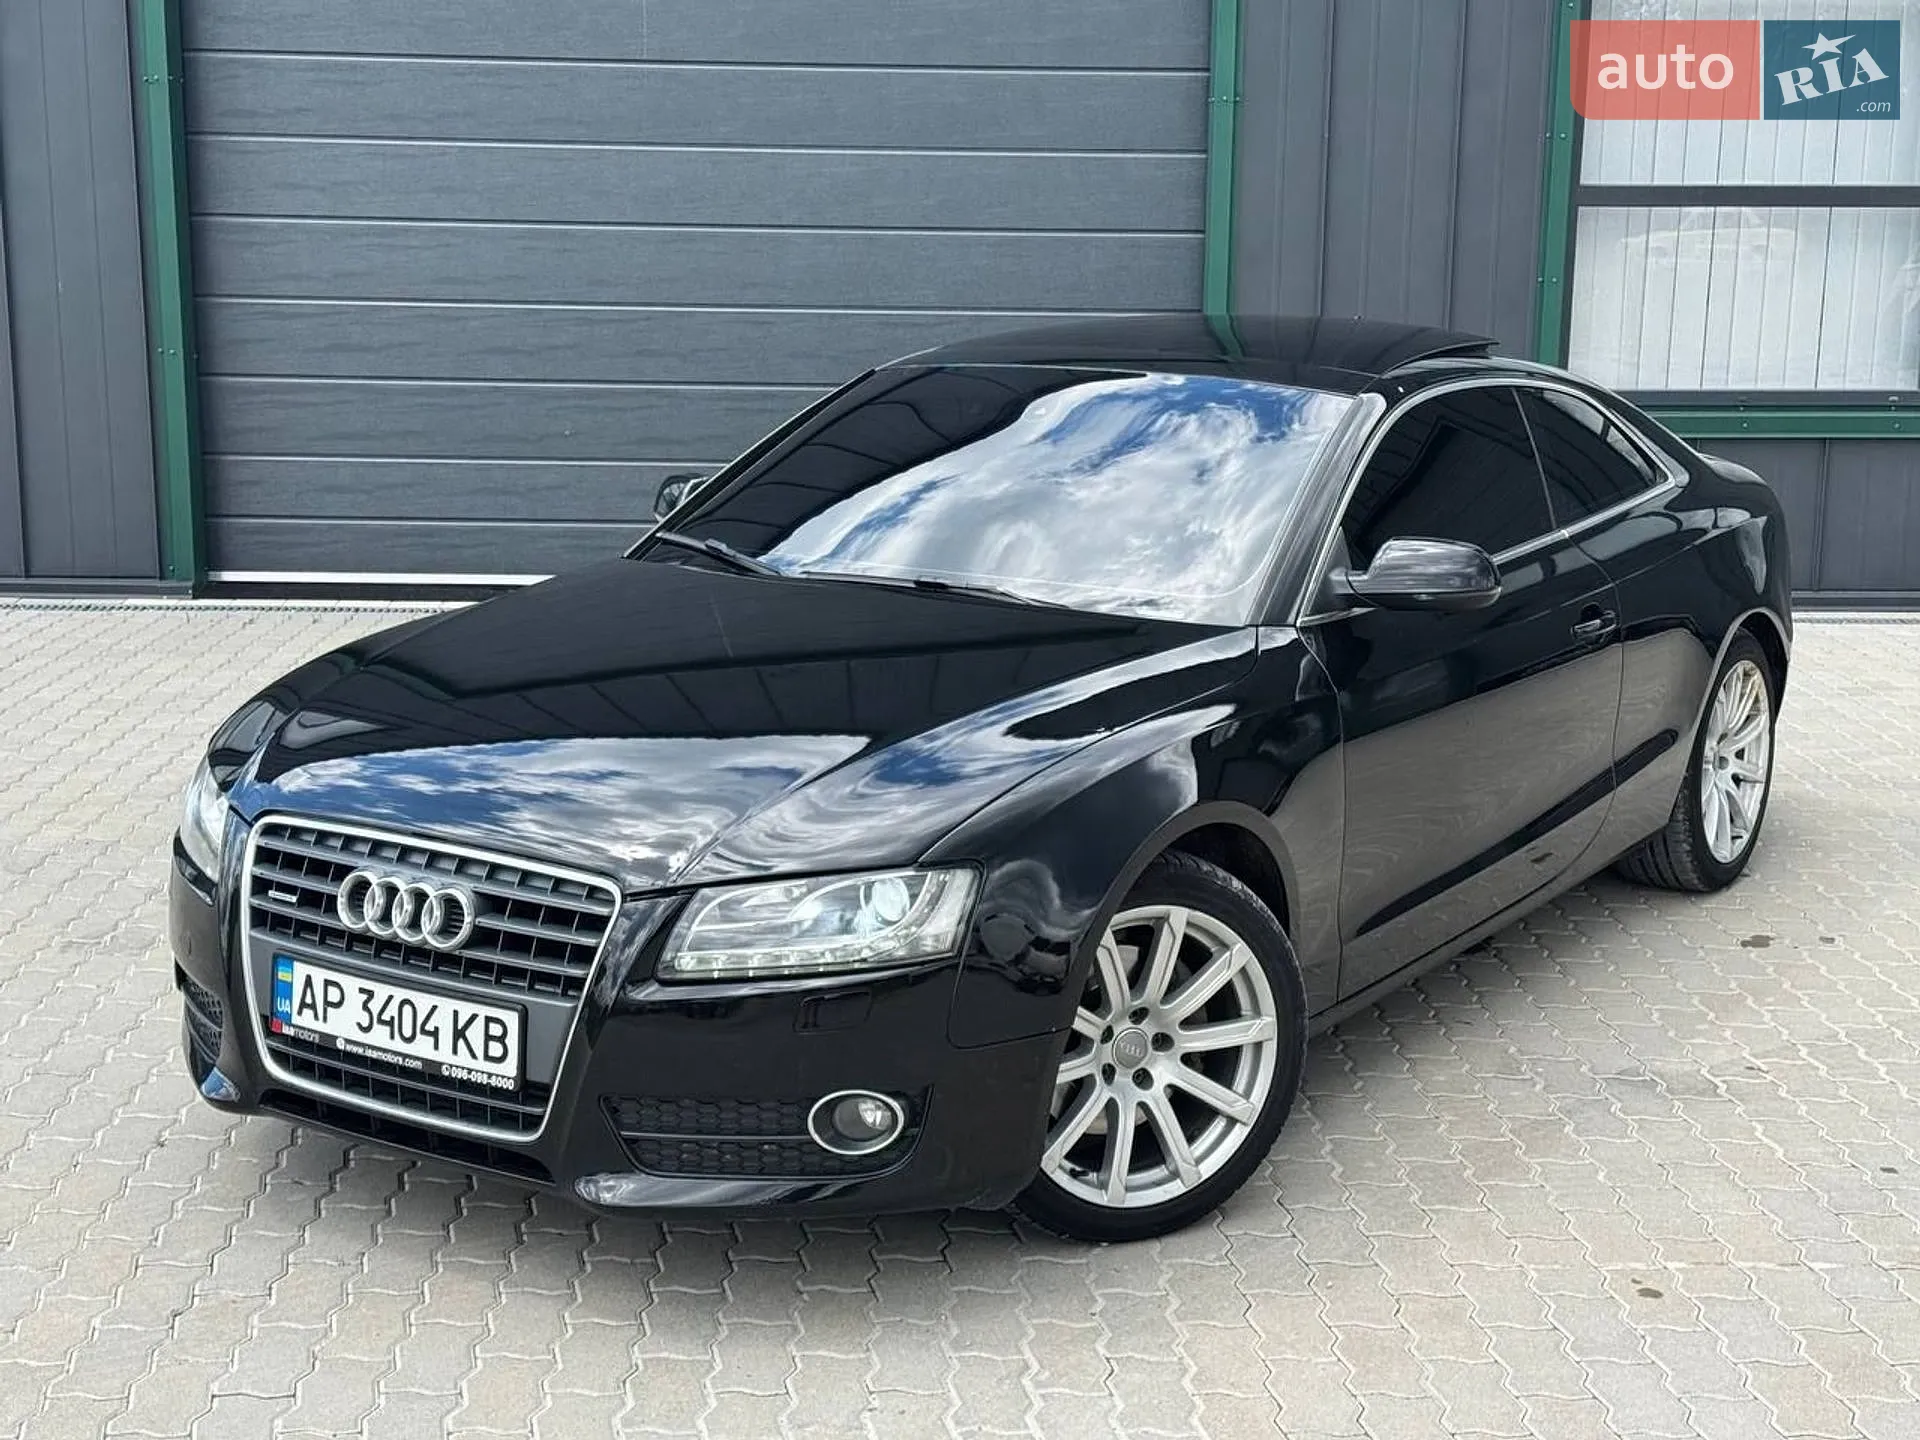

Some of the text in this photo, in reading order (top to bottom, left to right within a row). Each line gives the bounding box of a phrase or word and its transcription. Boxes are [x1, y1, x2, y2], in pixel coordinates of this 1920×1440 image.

[277, 997, 291, 1014] UA
[297, 974, 508, 1064] AP 3404 KB
